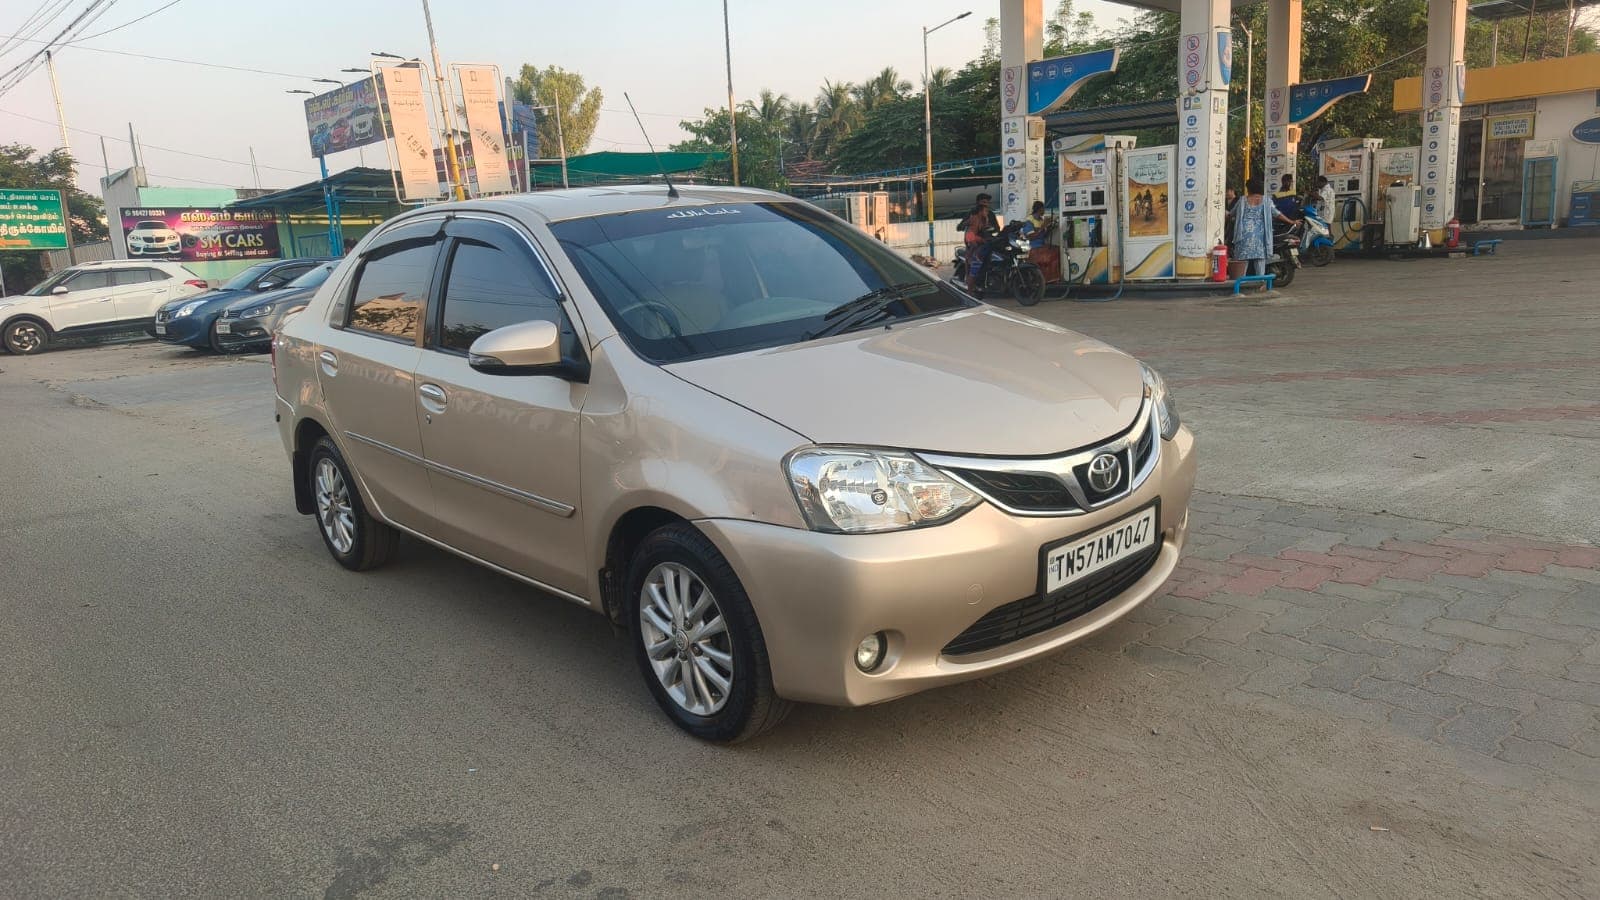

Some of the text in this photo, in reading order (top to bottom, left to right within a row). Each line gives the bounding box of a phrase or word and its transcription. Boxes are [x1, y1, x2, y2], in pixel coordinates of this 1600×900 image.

[200, 233, 265, 249] SM CARS
[1055, 516, 1150, 582] TN57AM7047
